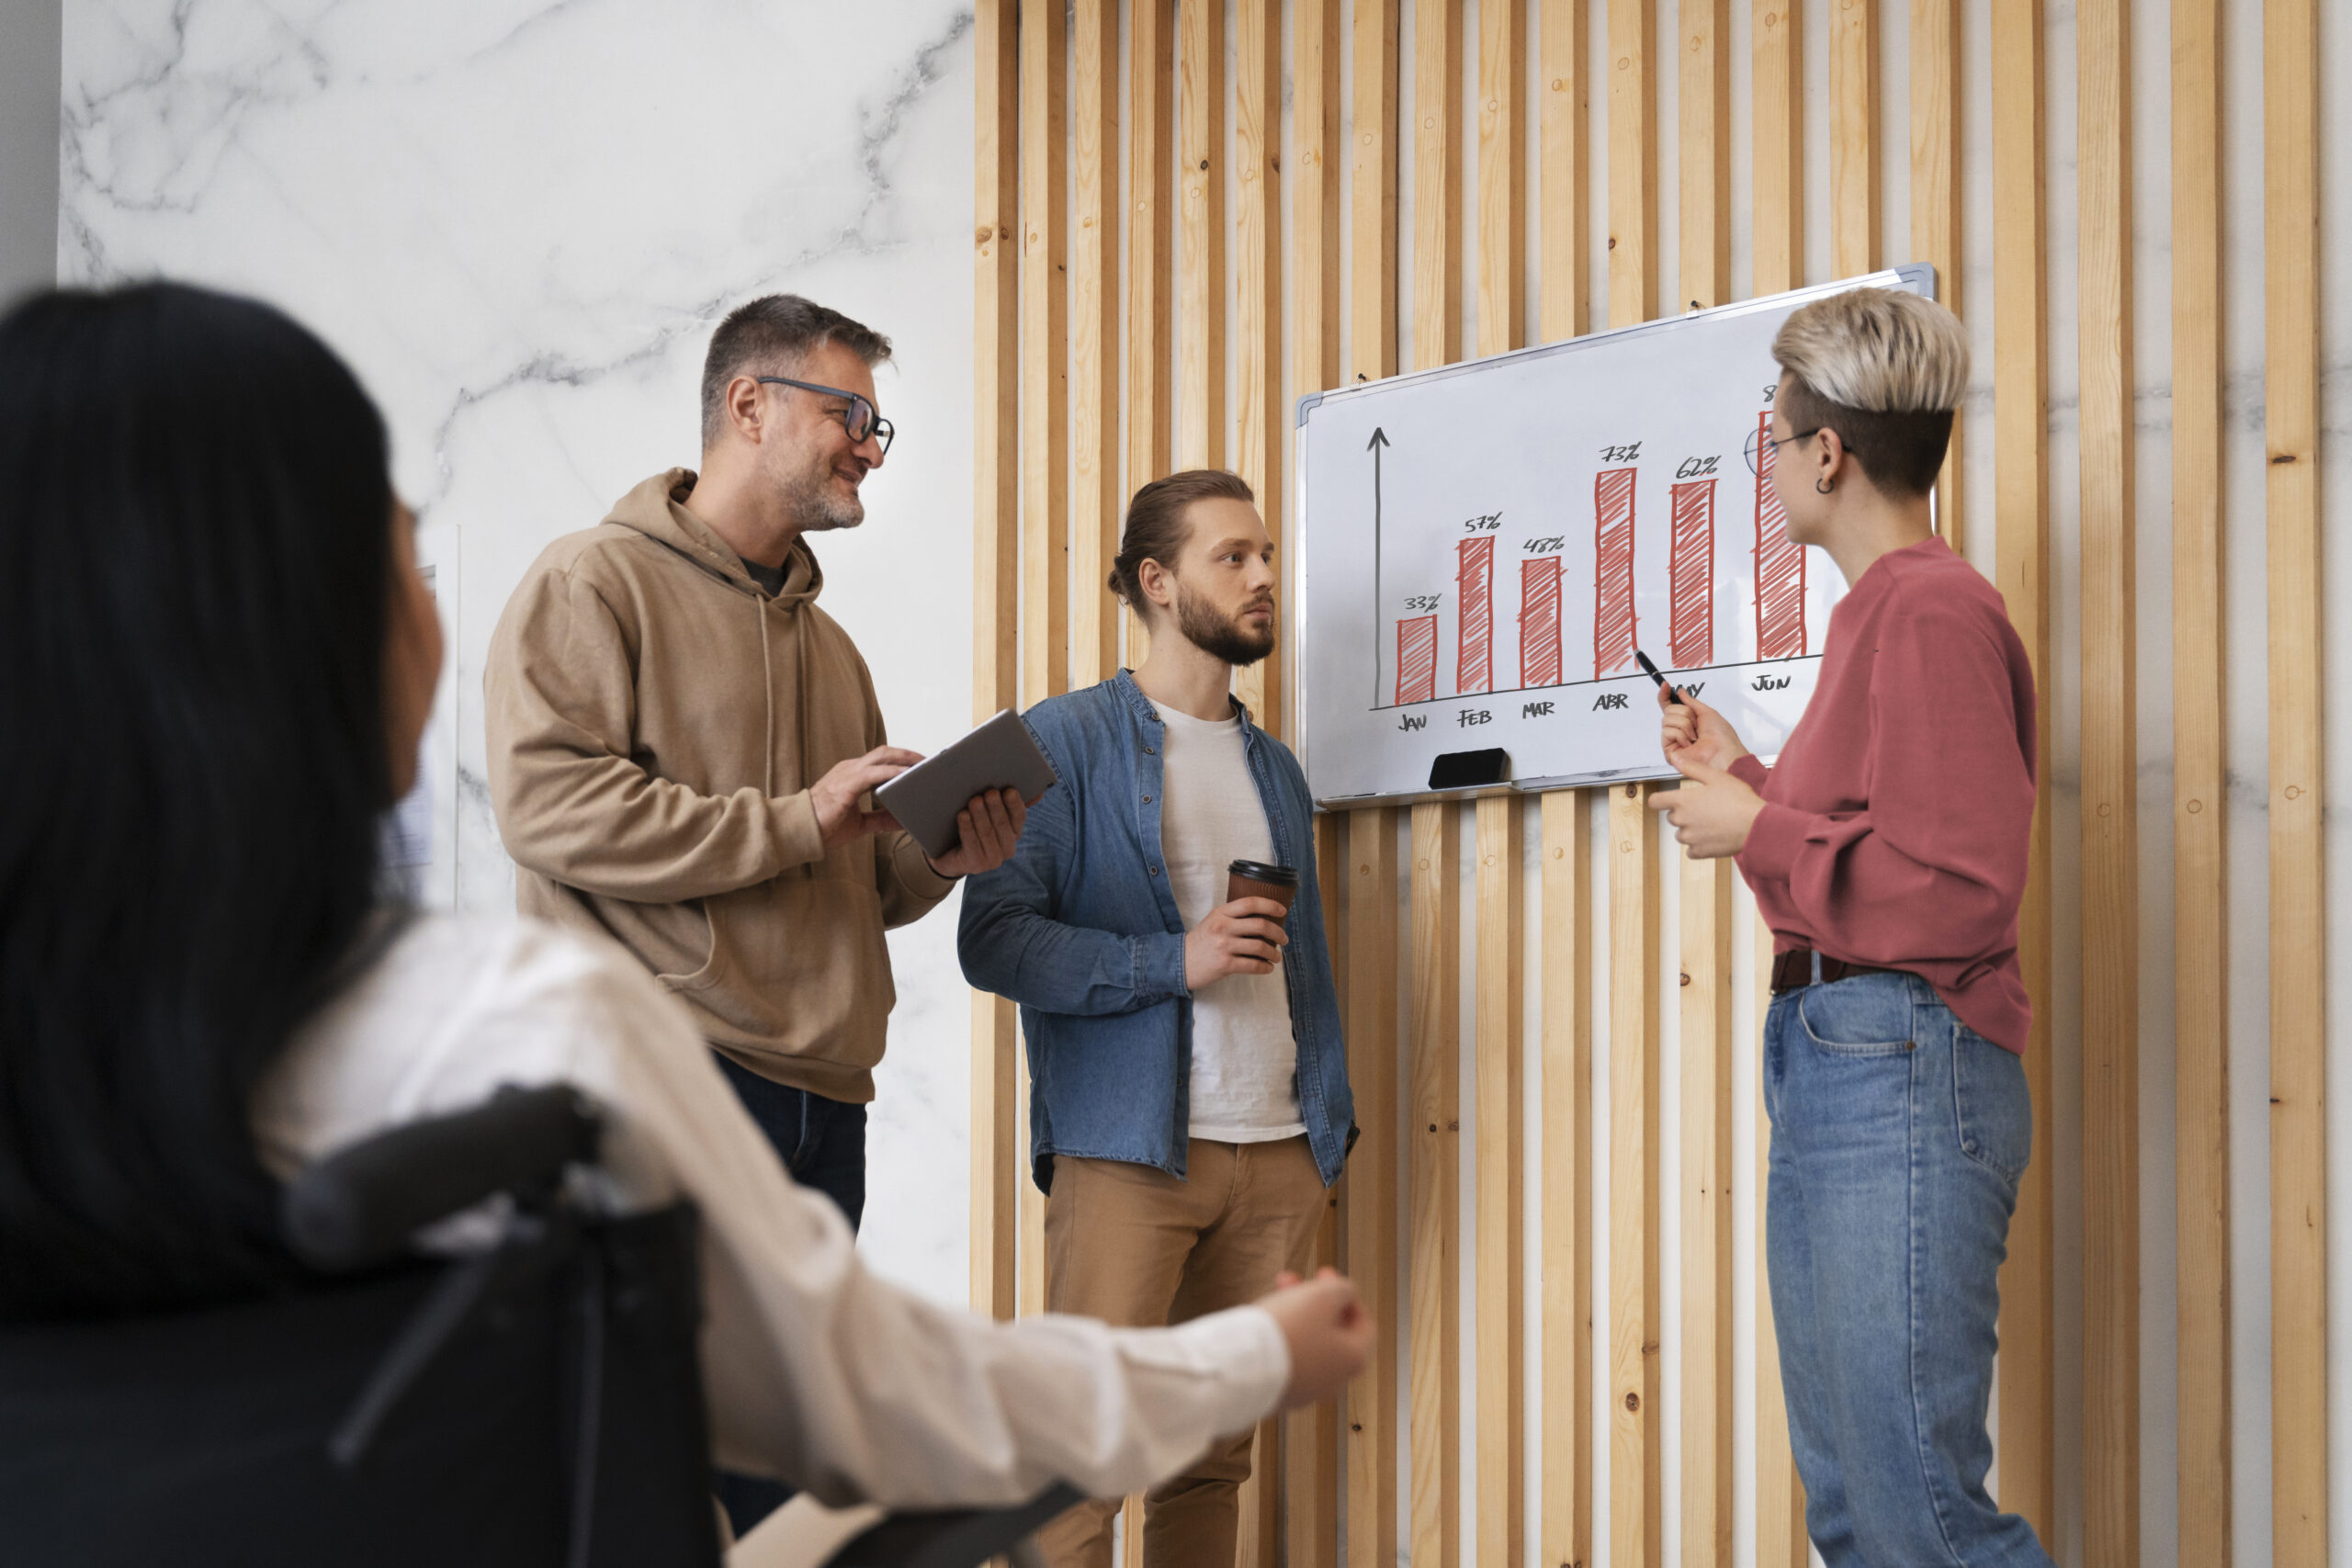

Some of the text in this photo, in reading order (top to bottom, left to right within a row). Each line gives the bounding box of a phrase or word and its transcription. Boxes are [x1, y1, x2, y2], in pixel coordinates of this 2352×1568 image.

[1600, 441, 1643, 463] 73%
[1676, 455, 1722, 479] 62%
[1464, 511, 1503, 533] 57%
[1522, 536, 1565, 554] 48%
[1403, 593, 1442, 614] 33%
[1397, 715, 1428, 732] JAN
[1456, 709, 1493, 728] FEB
[1522, 701, 1555, 719] MAR
[1592, 694, 1629, 712] ABR
[1751, 674, 1792, 692] JUN
